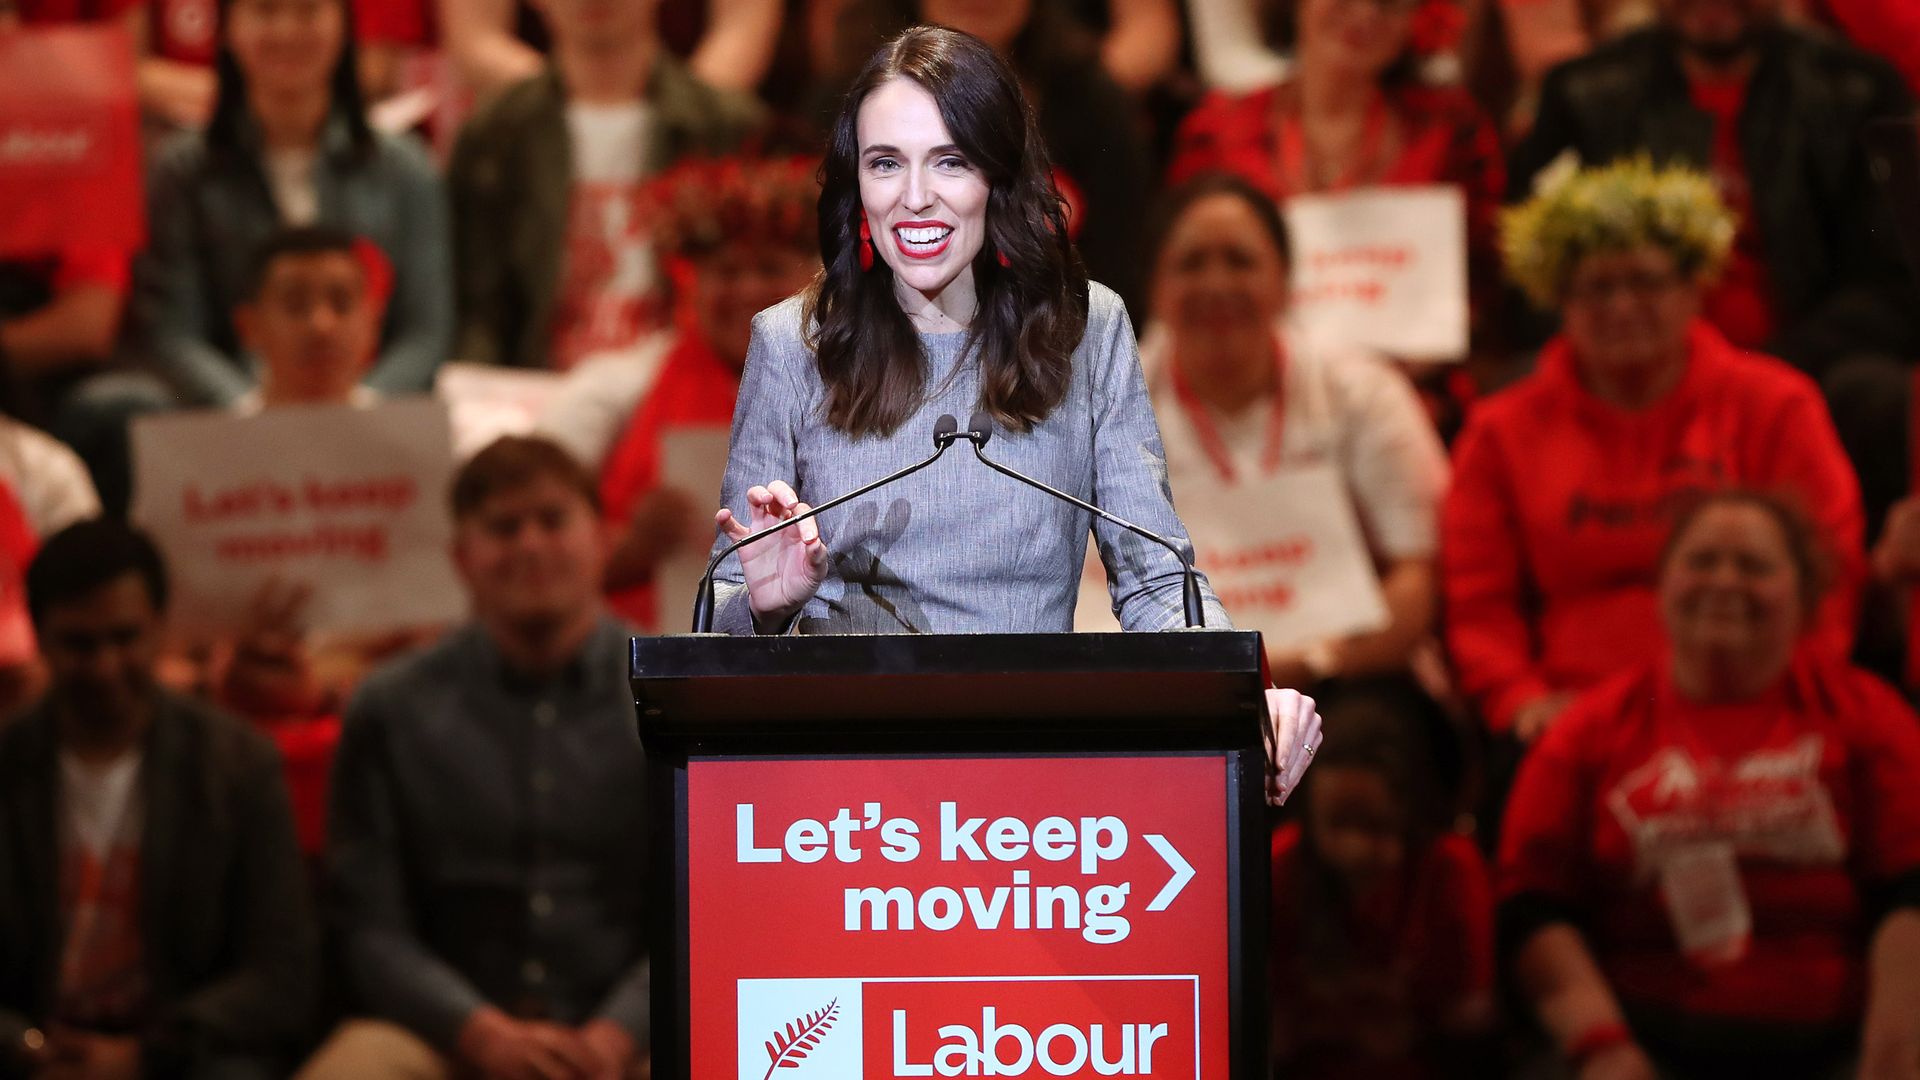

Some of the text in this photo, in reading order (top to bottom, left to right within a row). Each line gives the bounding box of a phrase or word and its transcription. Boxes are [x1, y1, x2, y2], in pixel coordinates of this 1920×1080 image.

[736, 801, 1129, 875] Let's keep
[844, 869, 1131, 944] moving
[892, 1006, 1168, 1077] Labour
